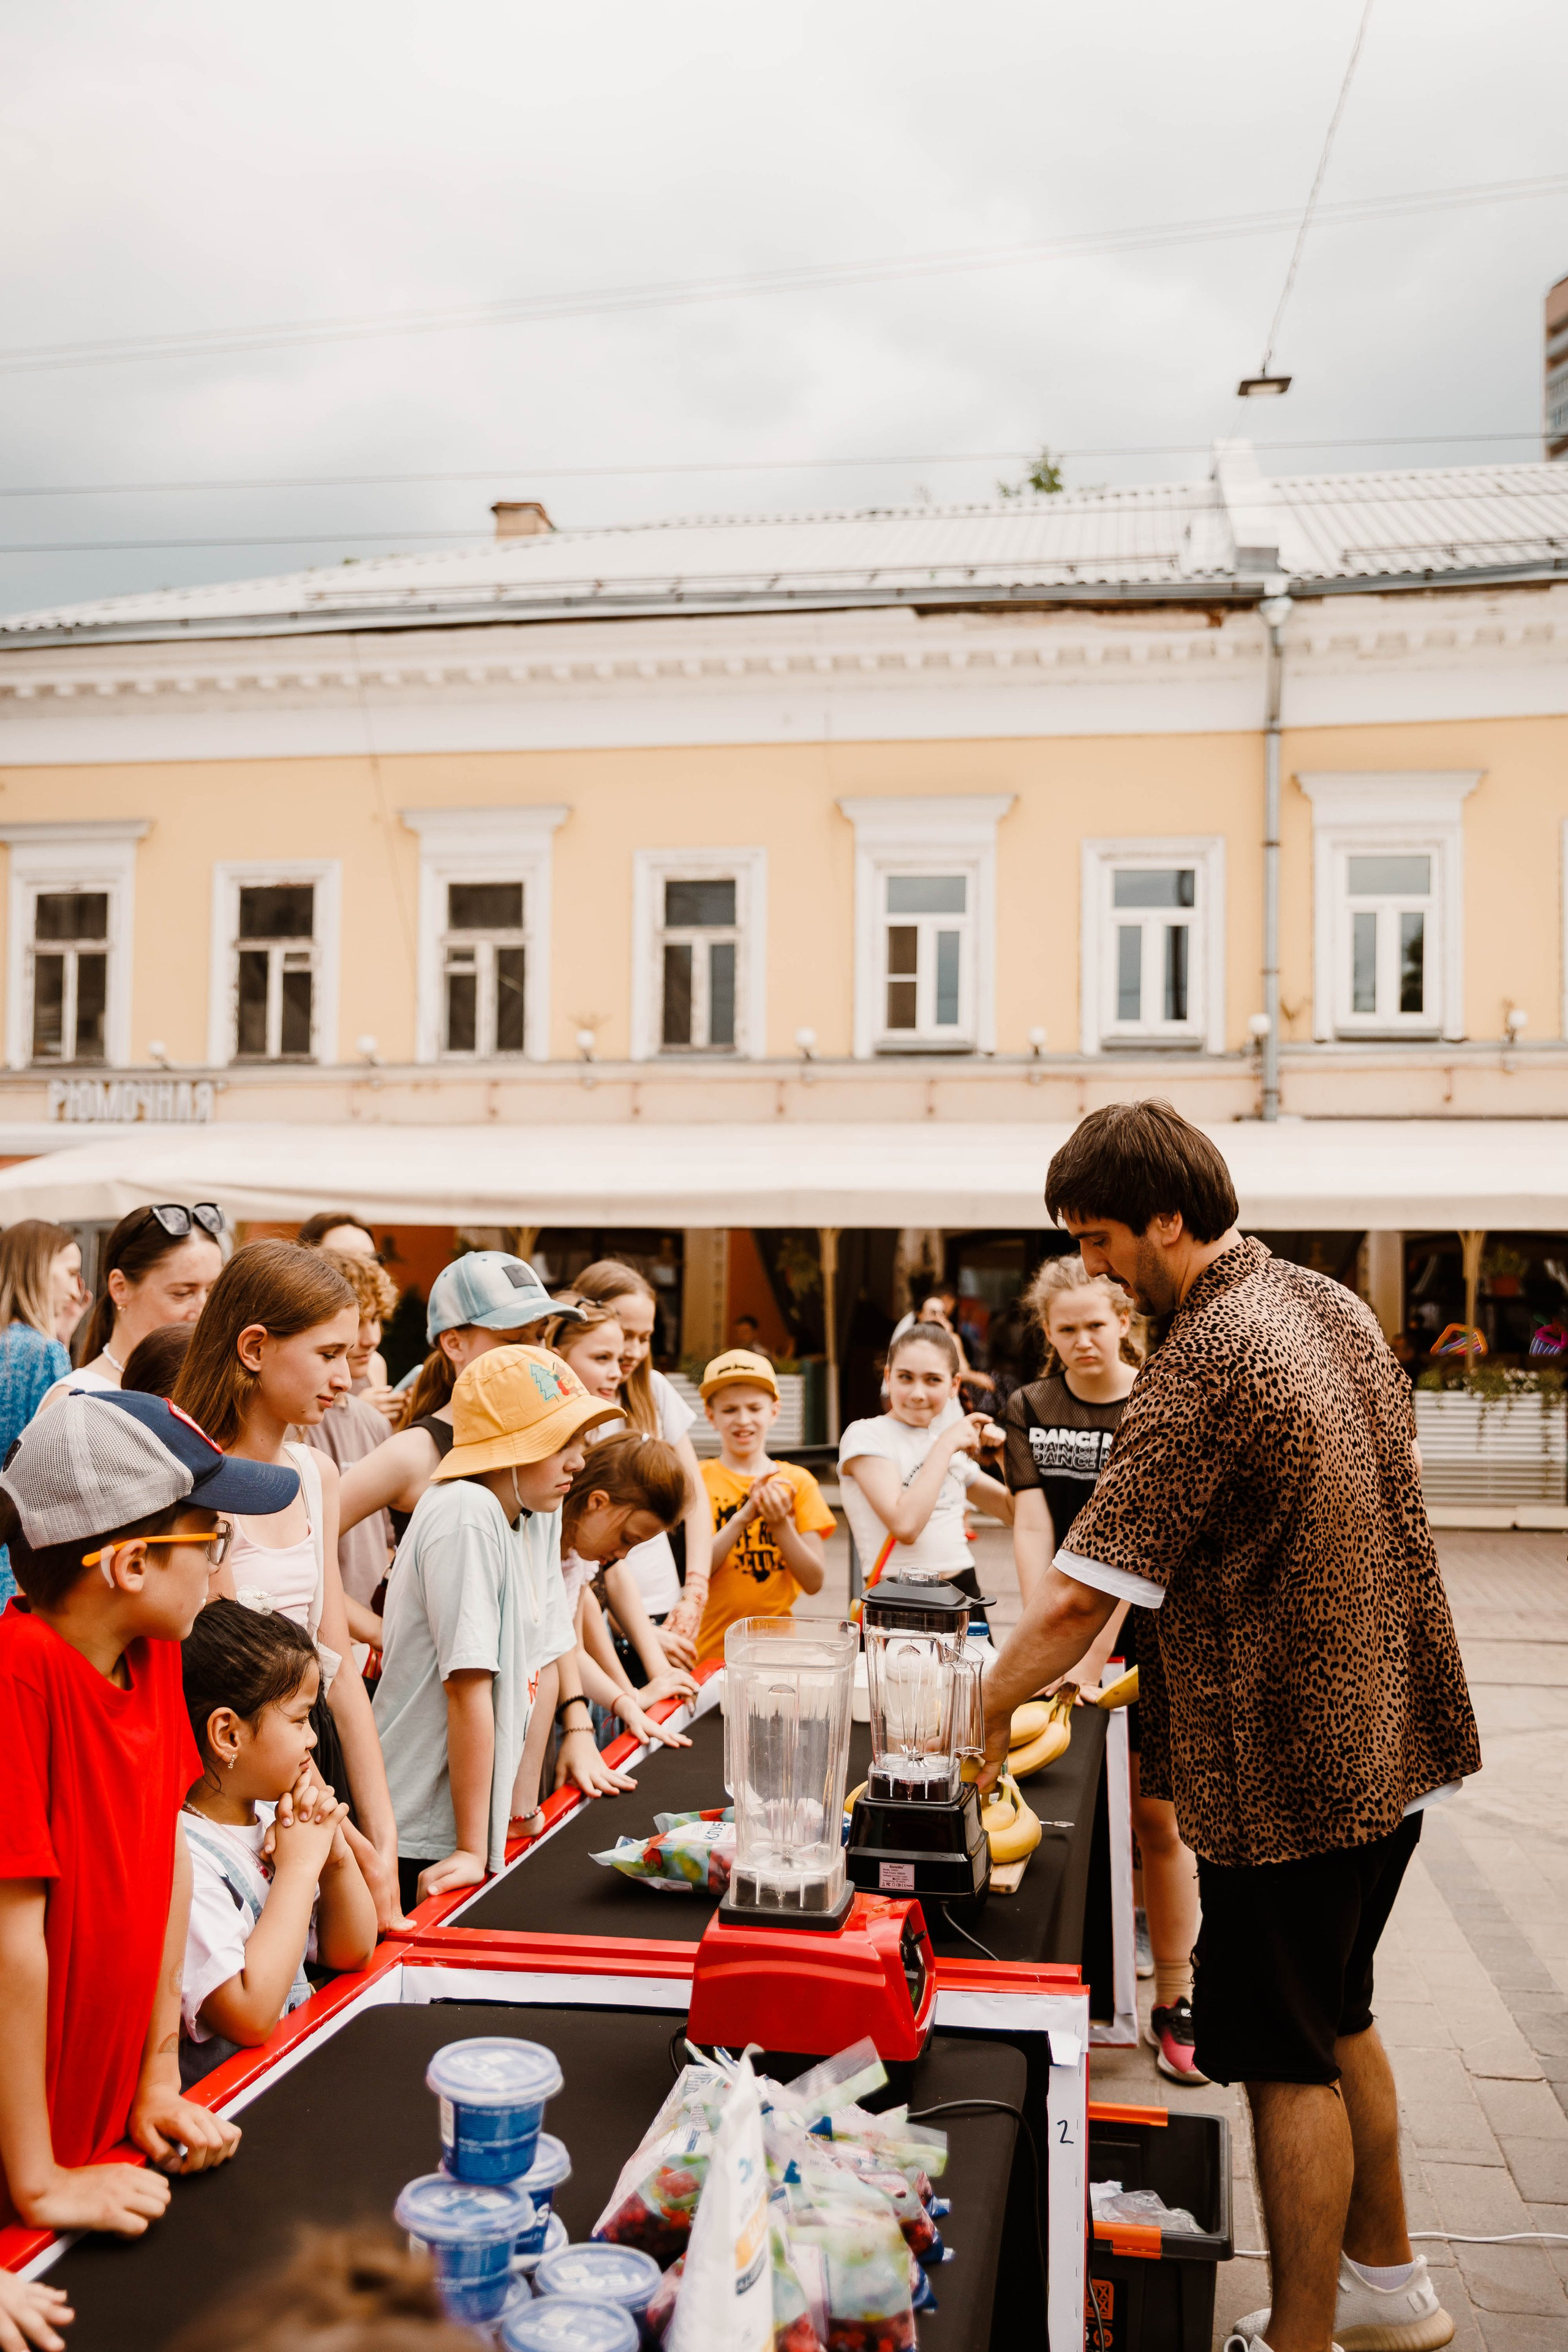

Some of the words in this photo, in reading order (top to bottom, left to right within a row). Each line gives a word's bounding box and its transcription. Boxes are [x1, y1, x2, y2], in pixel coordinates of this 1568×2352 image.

[48, 1080, 213, 1121] РЮМОЧНАЯ
[1029, 1427, 1101, 1449] DANCE
[1057, 2119, 1074, 2144] 2
